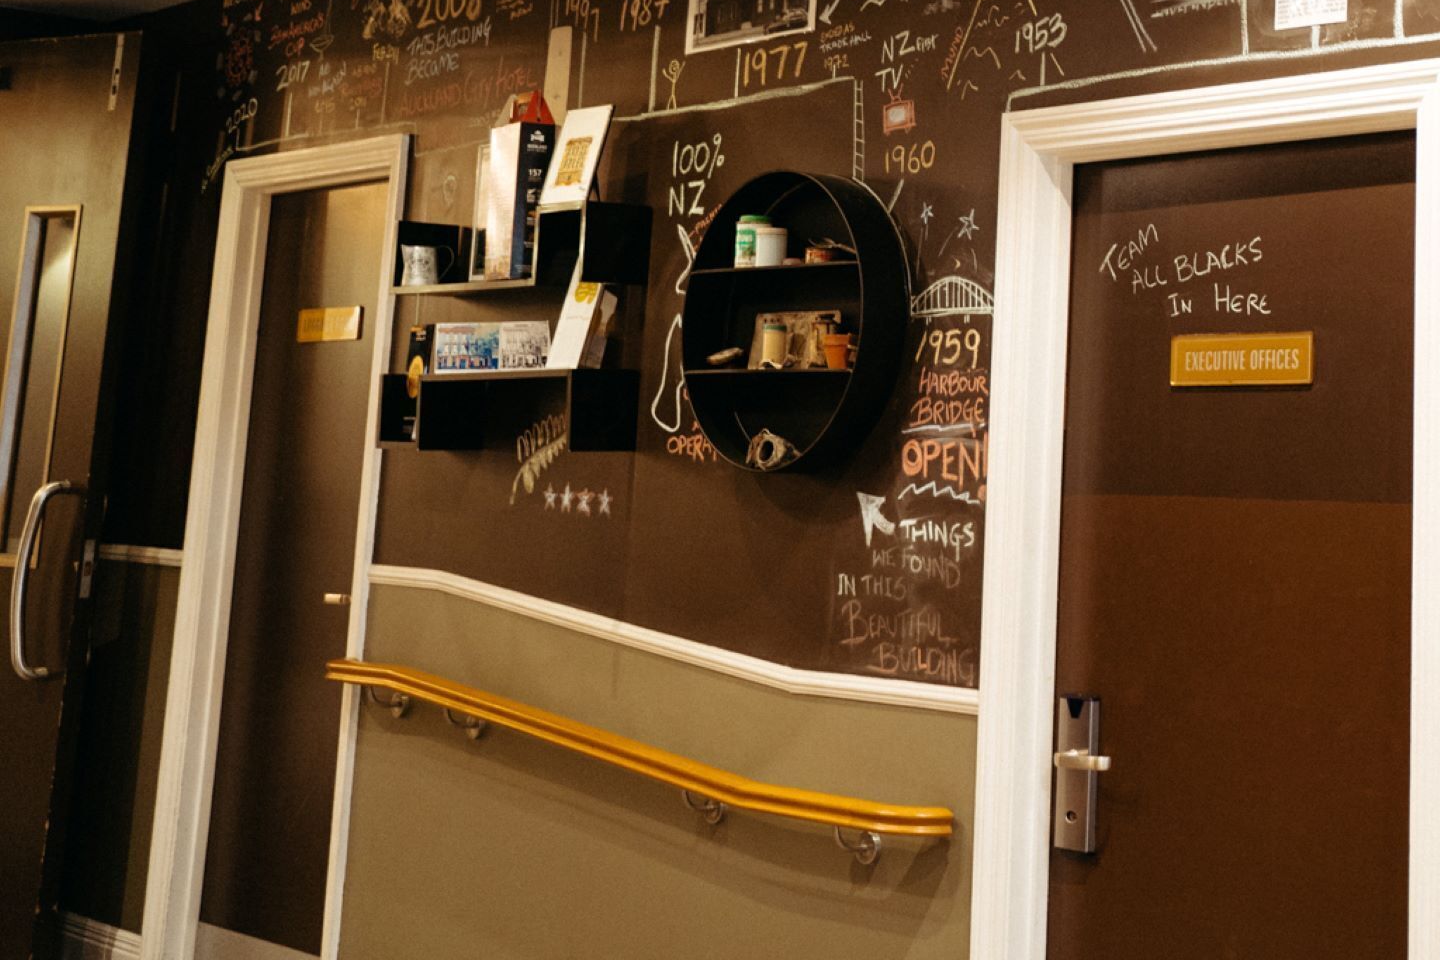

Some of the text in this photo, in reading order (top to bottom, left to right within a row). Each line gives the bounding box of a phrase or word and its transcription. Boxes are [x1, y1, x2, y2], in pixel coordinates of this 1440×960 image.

[881, 30, 915, 64] NZ
[1014, 12, 1067, 54] 1953
[276, 59, 310, 93] 2017
[742, 41, 808, 88] 1977
[875, 63, 904, 93] TV
[672, 133, 725, 179] 100%
[884, 140, 937, 174] 1960
[668, 180, 706, 217] NZ
[1099, 224, 1159, 280] TEAM
[1131, 236, 1263, 294] ALL BLACKS
[1167, 283, 1272, 318] IN HERE
[915, 328, 981, 369] 1959
[1185, 348, 1300, 372] EXECUTIVE OFFICES
[919, 366, 989, 396] HARBOUR
[909, 397, 986, 436] BRIDGE
[899, 519, 976, 562] THINGS
[837, 573, 856, 596] IN
[872, 544, 960, 589] WE FOUND
[840, 598, 958, 644] BEAUTIFUL
